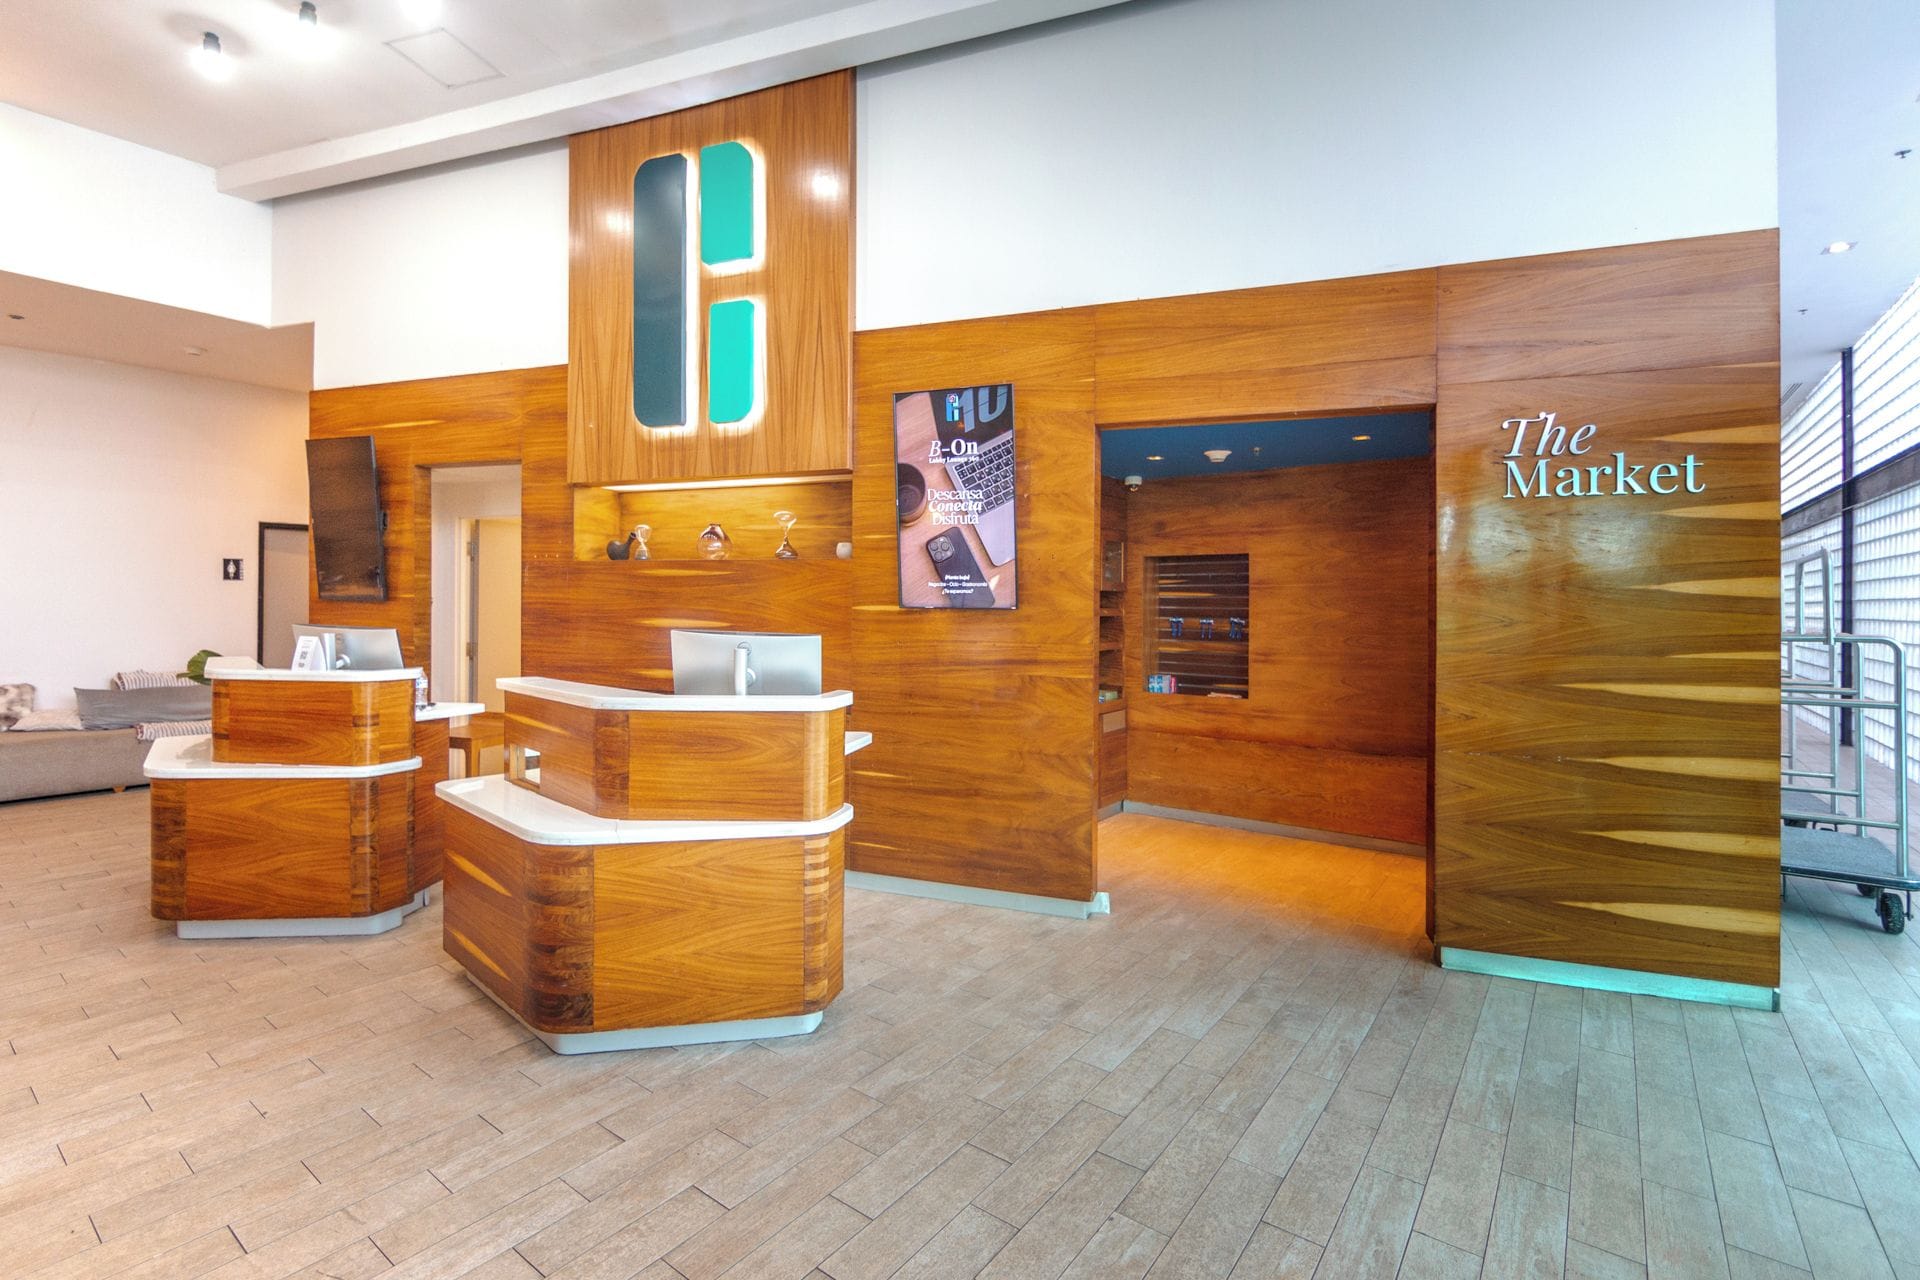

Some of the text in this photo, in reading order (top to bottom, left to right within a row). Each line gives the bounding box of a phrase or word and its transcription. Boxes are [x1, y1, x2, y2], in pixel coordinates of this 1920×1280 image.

[1501, 411, 1597, 457] The
[928, 438, 979, 457] B-On
[1503, 452, 1706, 498] Market
[927, 488, 983, 501] Descansa
[928, 500, 982, 512] Conecta
[932, 511, 979, 525] Disfruta
